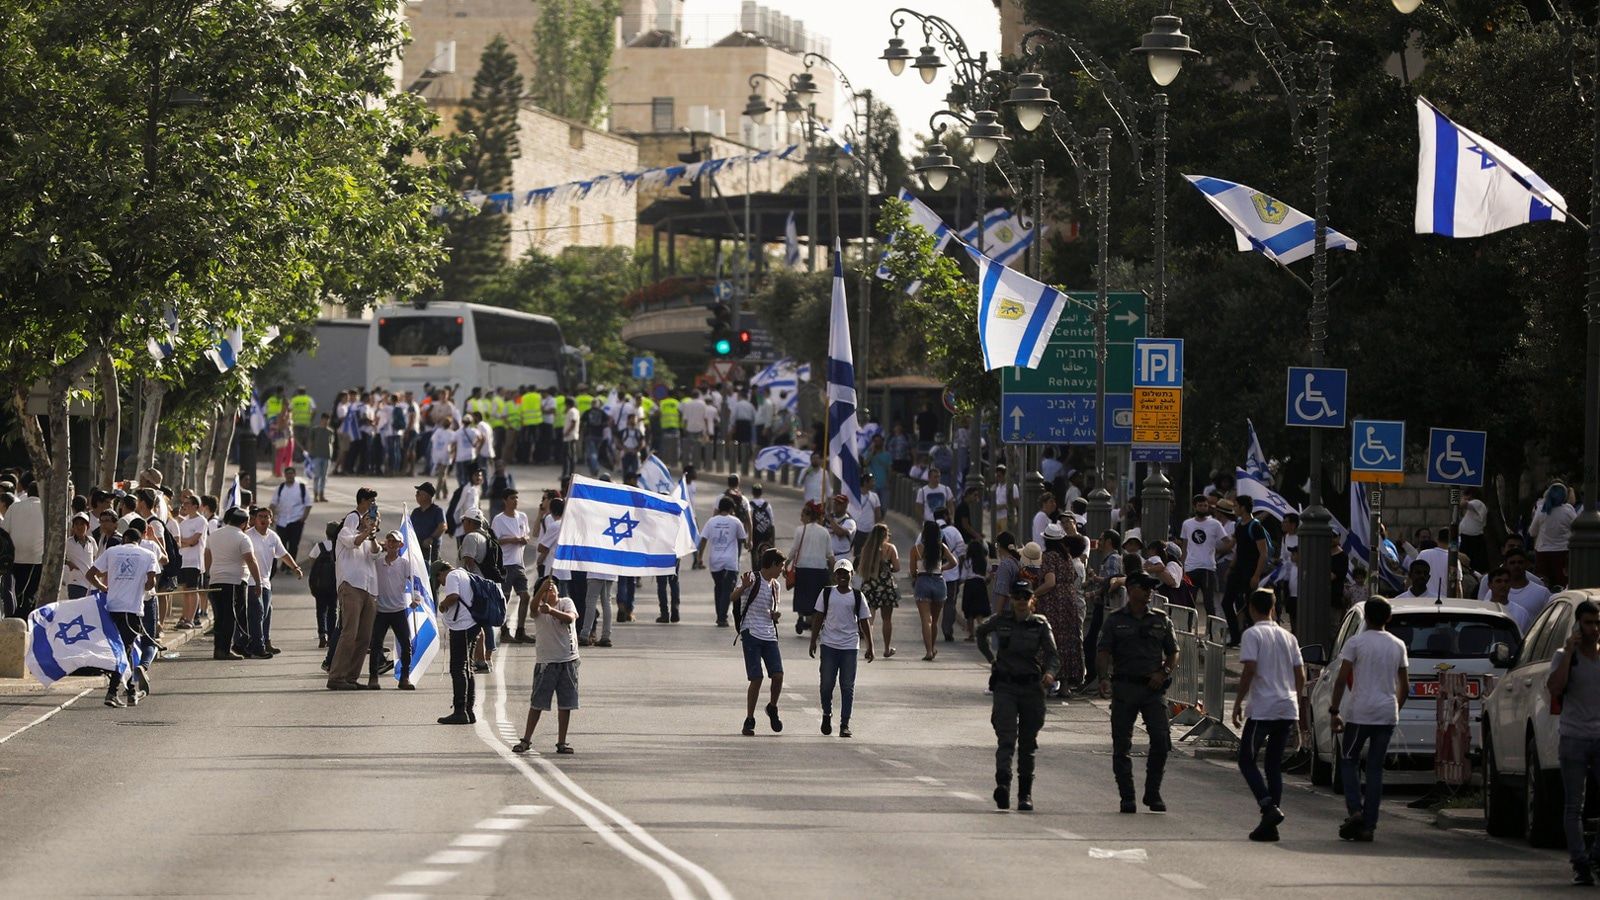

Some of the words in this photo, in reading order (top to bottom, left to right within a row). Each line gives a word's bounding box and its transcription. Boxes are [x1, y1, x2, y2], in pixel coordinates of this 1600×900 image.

[1054, 327, 1095, 336] Center
[1056, 348, 1094, 358] רחביה
[1047, 399, 1076, 409] אביב
[1049, 426, 1066, 437] Tel
[1153, 431, 1160, 440] 3
